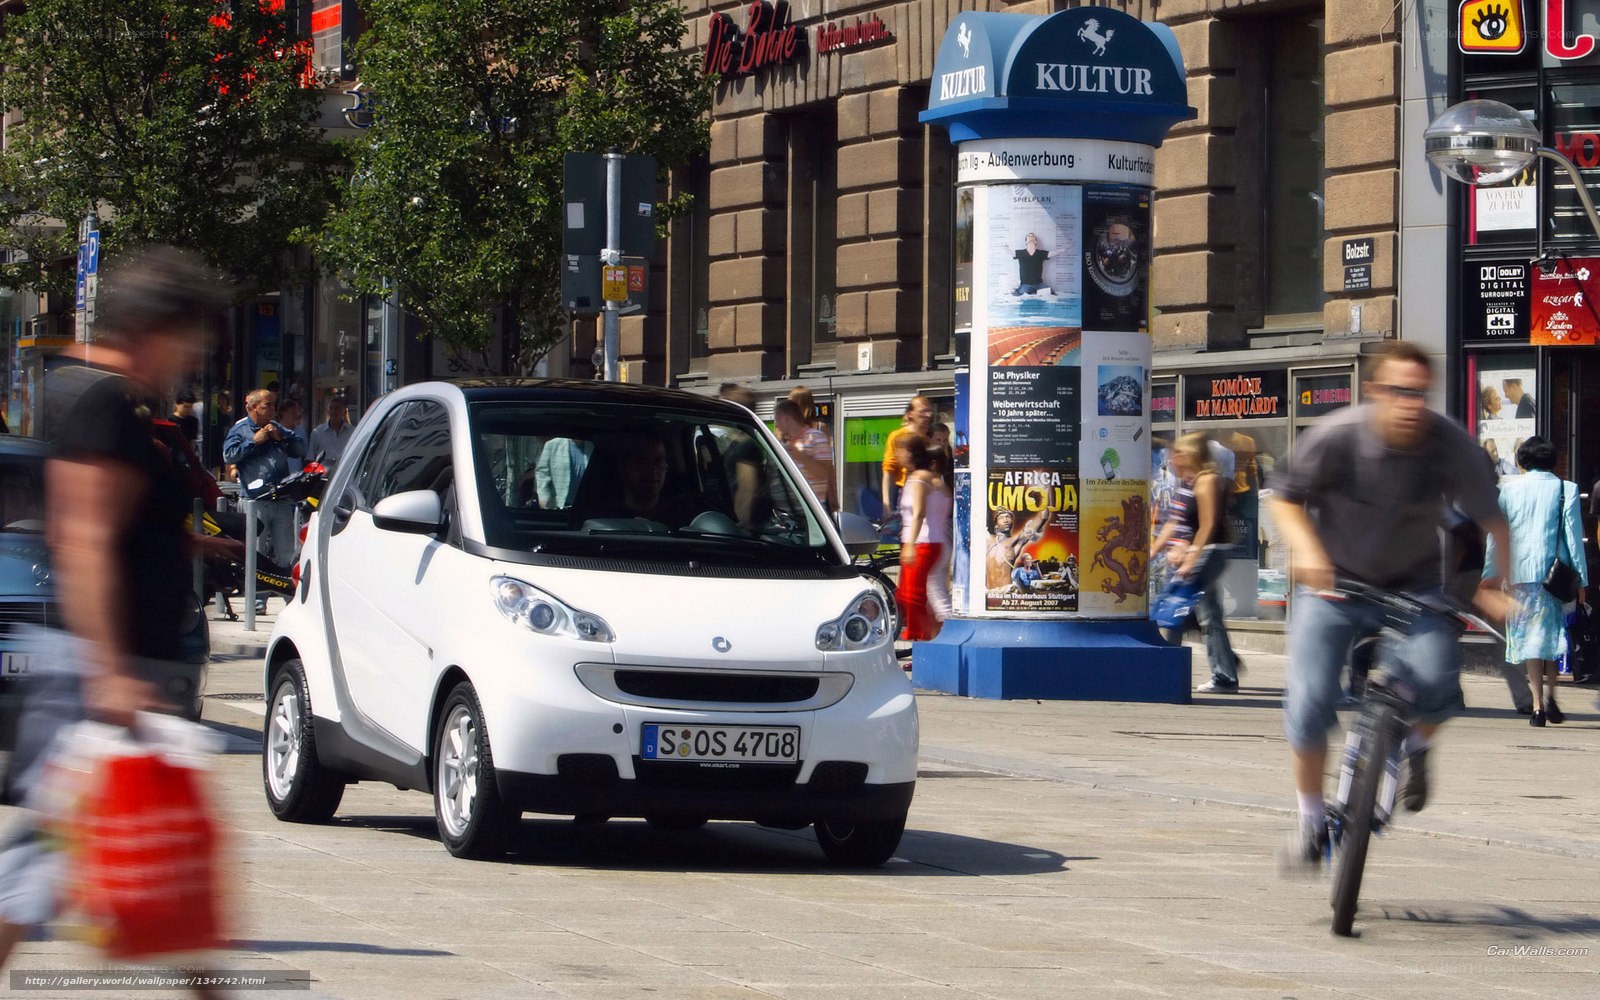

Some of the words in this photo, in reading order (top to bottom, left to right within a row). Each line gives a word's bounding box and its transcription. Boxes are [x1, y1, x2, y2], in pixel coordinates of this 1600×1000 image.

[705, 13, 732, 75] Die
[740, 0, 796, 72] Bohne
[817, 22, 844, 53] Kaffee
[940, 65, 986, 101] KULTUR
[1035, 63, 1153, 96] KULTUR
[988, 151, 1075, 168] Außenwerbung
[1485, 191, 1503, 201] VON
[1504, 190, 1525, 200] FRAU
[1488, 201, 1498, 211] ZU
[1502, 200, 1521, 210] FRAU
[89, 237, 96, 269] P
[1346, 242, 1370, 260] Bolzstr.
[1499, 268, 1522, 277] DOLBY
[1480, 281, 1524, 290] DIGITAL
[1490, 316, 1511, 326] dts
[1486, 328, 1515, 336] SOUND
[993, 372, 1005, 380] Die
[1006, 371, 1041, 381] Physiker
[1211, 374, 1262, 397] KOMÖDIE
[993, 400, 1061, 409] Weiberwirtschaft
[1196, 399, 1210, 417] IM
[1211, 396, 1279, 419] MARQUARDT
[1005, 470, 1062, 486] AFRICA
[1096, 478, 1120, 486] Zeichen
[988, 482, 1078, 513] UMOJA
[988, 592, 1003, 600] Afrika
[1011, 592, 1047, 600] Theaterhaus
[1048, 593, 1076, 601] Stuttgart
[647, 745, 653, 753] D
[660, 729, 676, 755] S
[694, 730, 727, 757] OS
[733, 731, 795, 758] 4708
